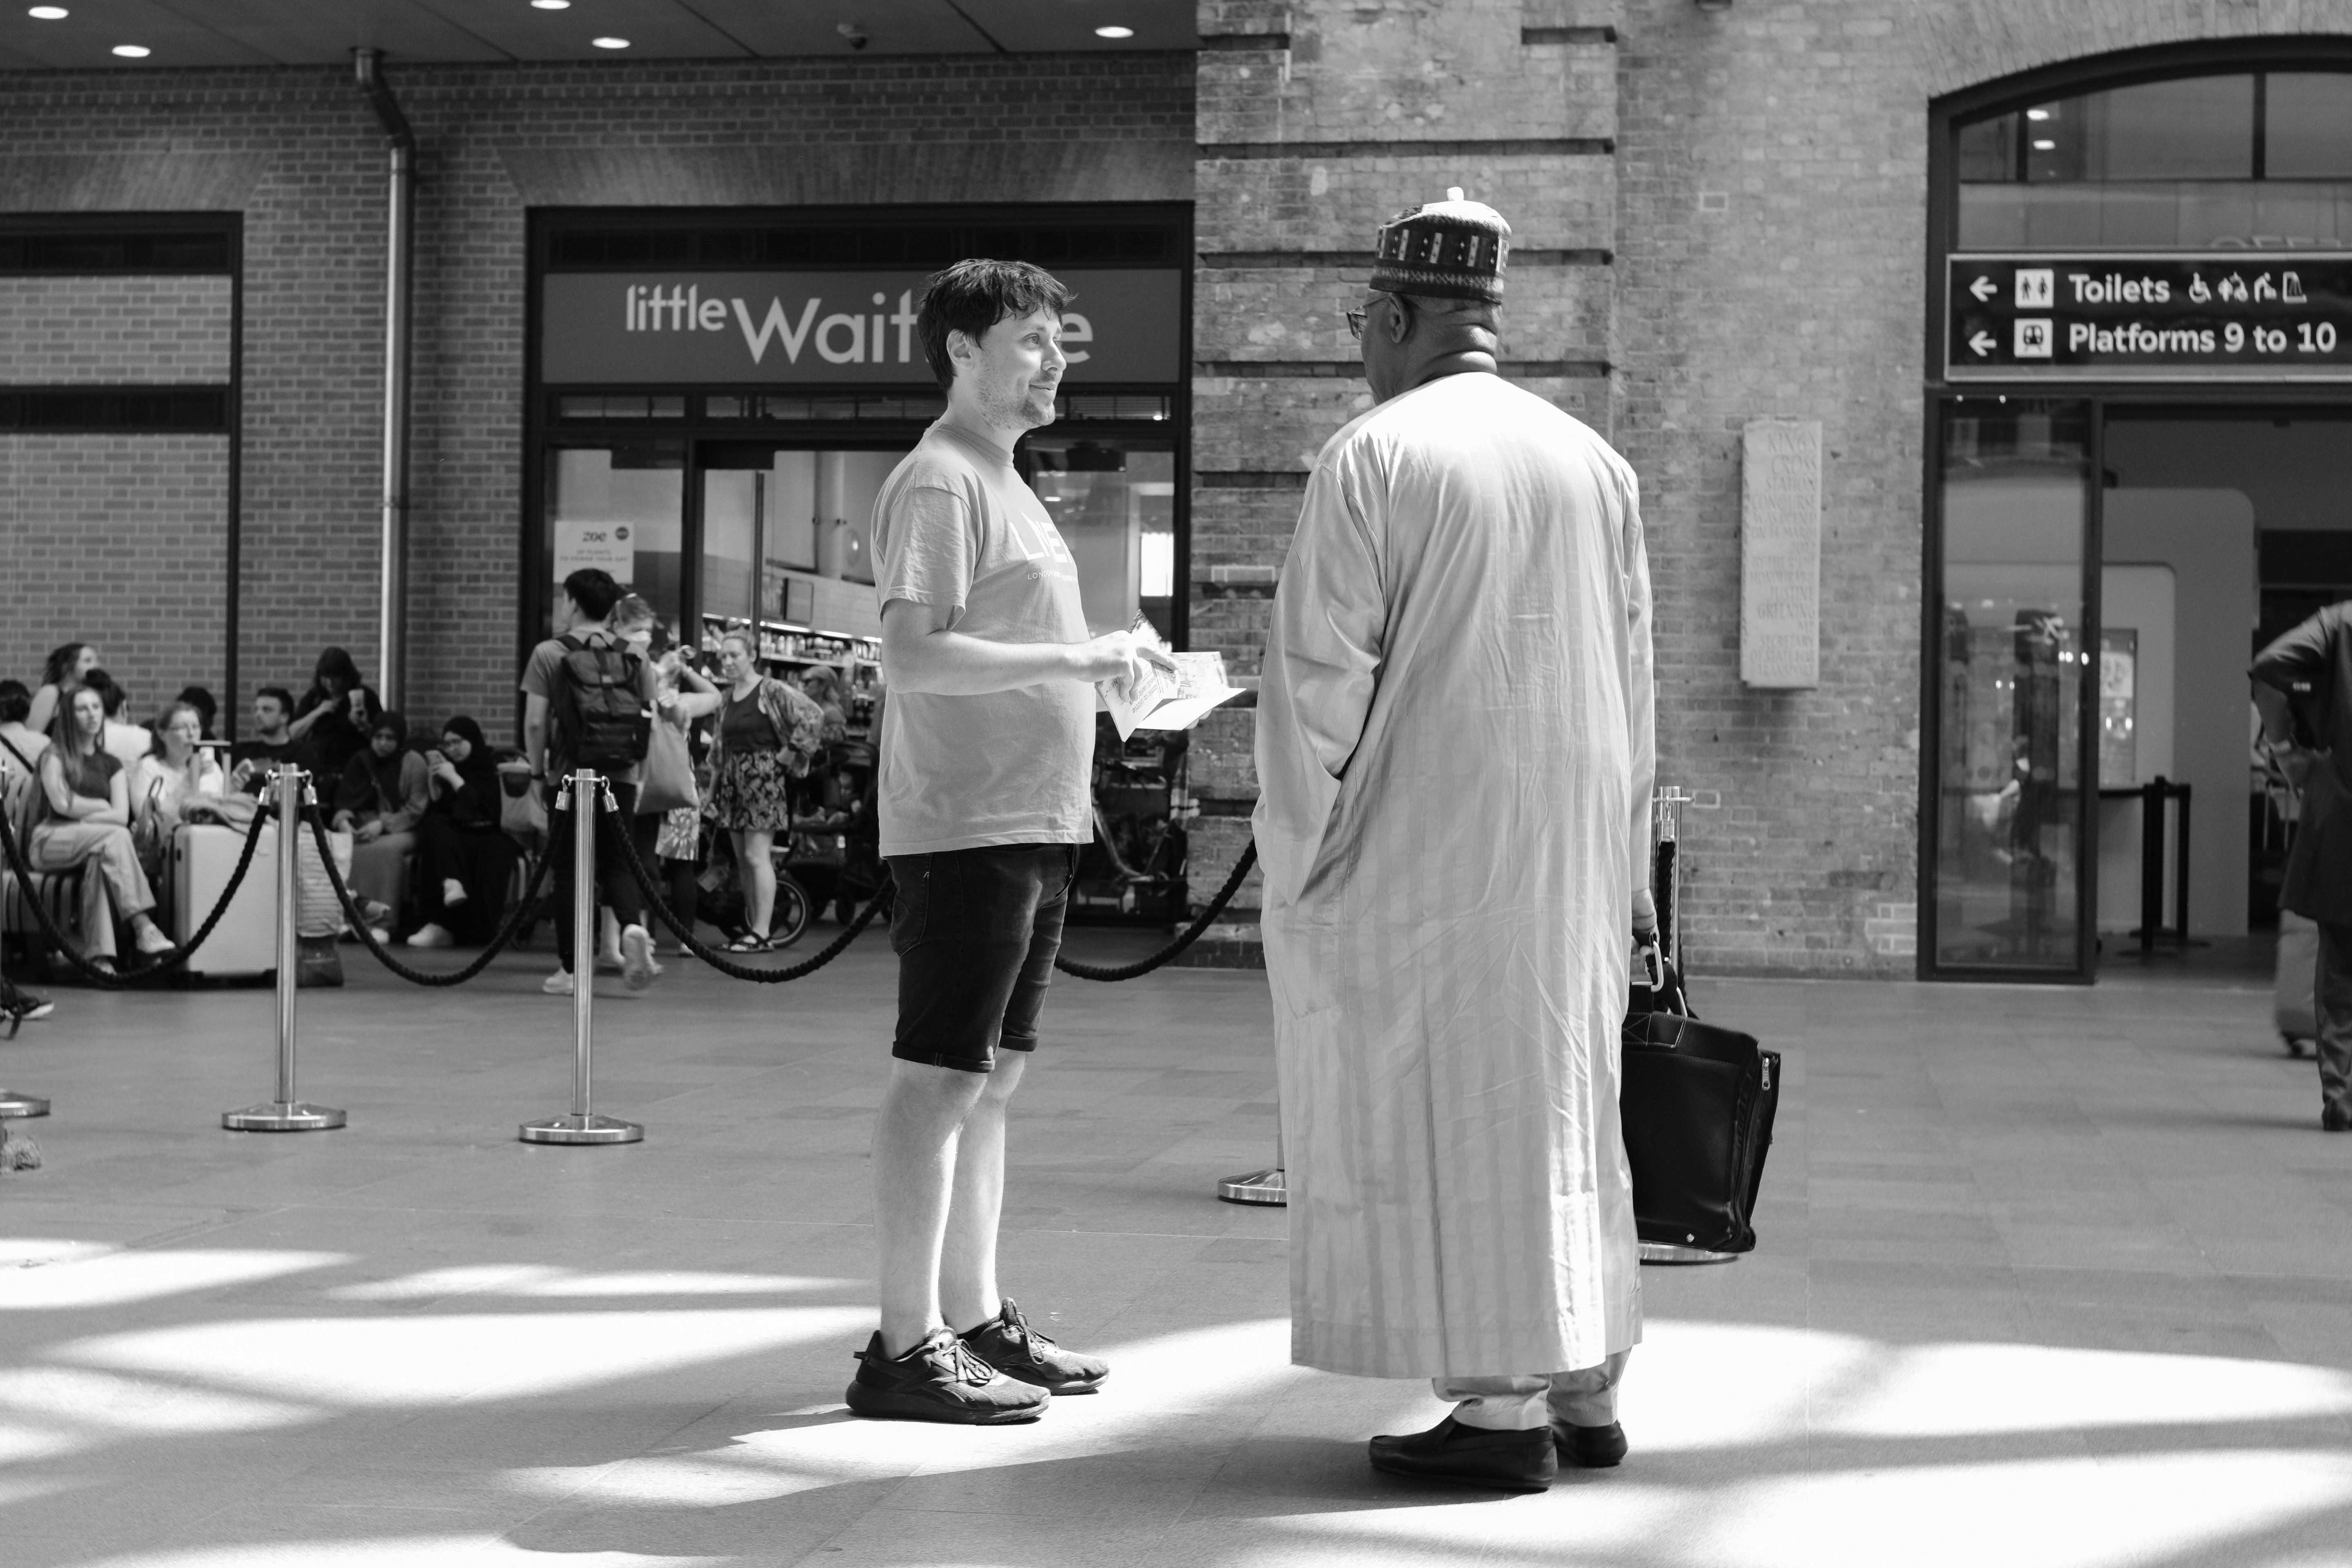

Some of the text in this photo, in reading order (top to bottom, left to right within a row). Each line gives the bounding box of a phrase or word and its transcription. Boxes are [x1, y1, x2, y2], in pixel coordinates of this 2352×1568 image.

[2068, 273, 2170, 304] Toilets
[626, 283, 1093, 365] little Waite
[2069, 322, 2336, 353] Platforms 9 to 10
[1771, 454, 1817, 475] CROSS
[1028, 570, 1053, 580] LONDON
